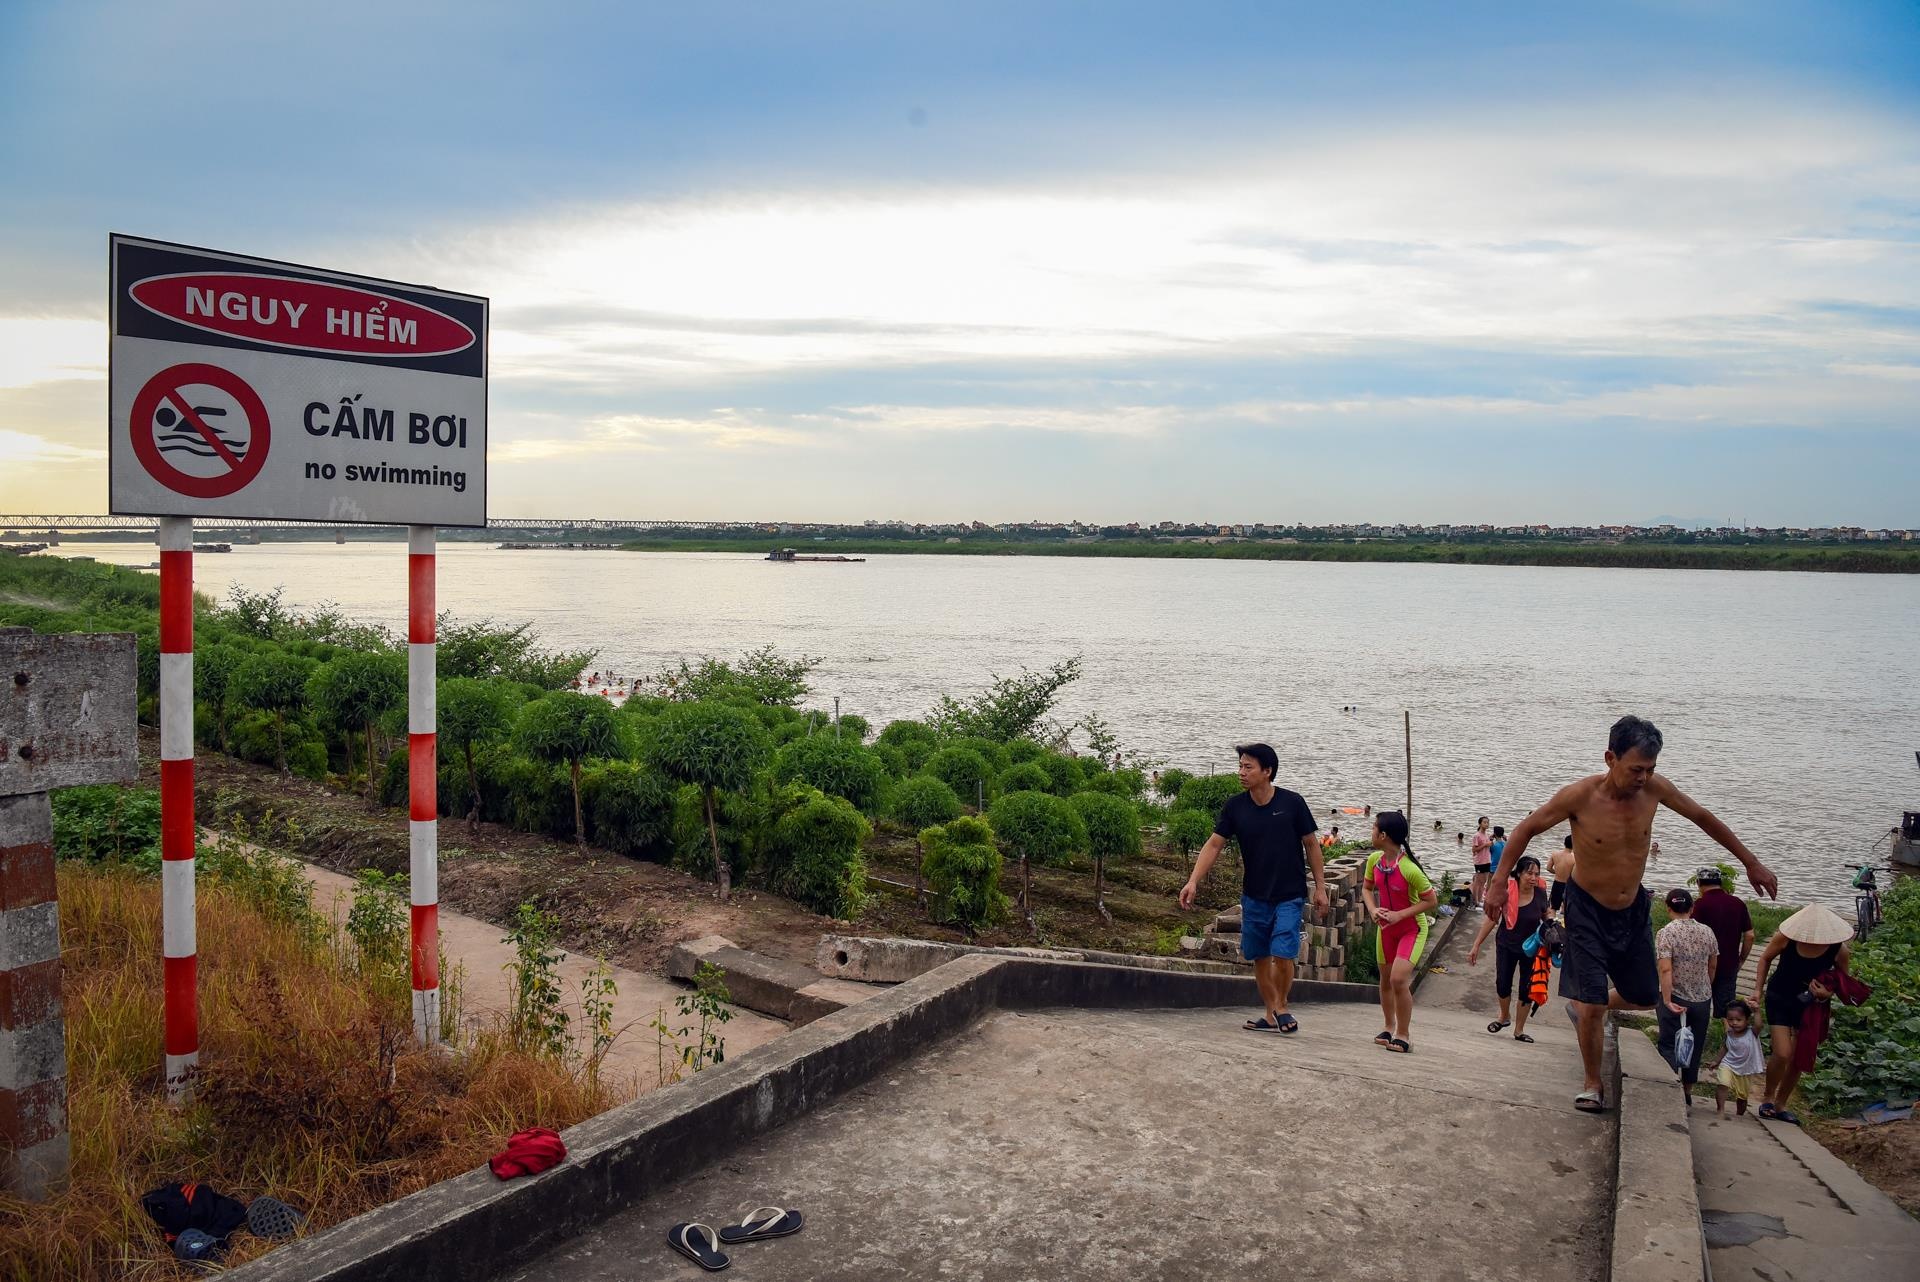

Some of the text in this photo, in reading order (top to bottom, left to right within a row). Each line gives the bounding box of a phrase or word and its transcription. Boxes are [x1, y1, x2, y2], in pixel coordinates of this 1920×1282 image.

[185, 286, 418, 346] NGUY HIỂM
[303, 394, 467, 448] CẤM BƠI
[305, 461, 467, 492] no swimming
